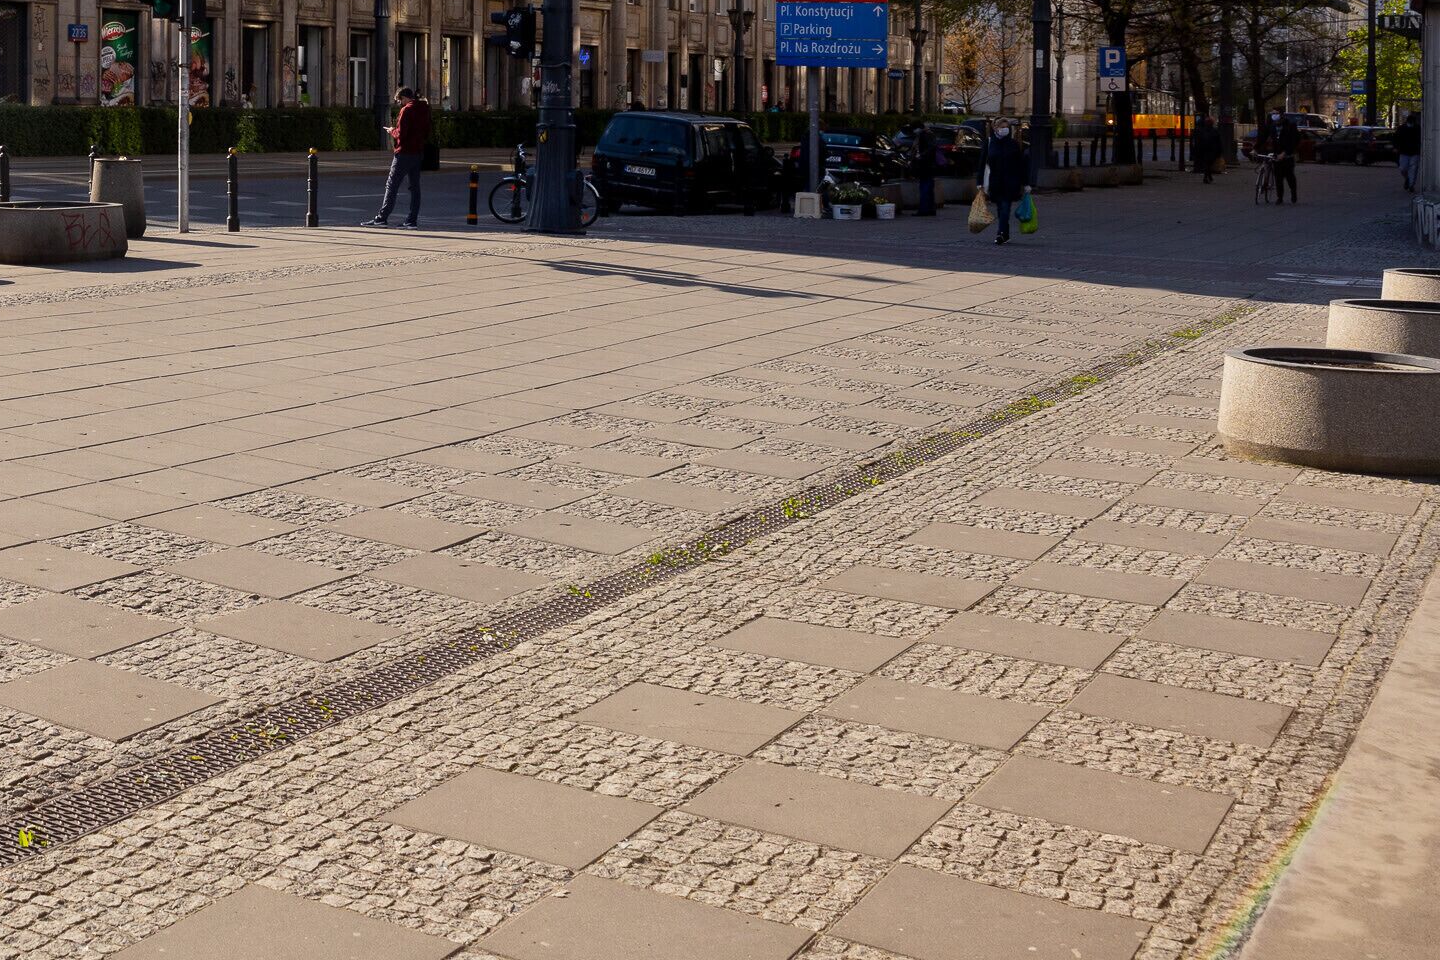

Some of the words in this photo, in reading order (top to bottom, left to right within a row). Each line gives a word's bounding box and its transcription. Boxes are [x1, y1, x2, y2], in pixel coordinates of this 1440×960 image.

[780, 6, 792, 16] Pl.
[795, 6, 854, 19] Konstytucji
[793, 23, 832, 37] Parking
[780, 42, 792, 53] Pl.
[795, 42, 809, 53] Na
[811, 42, 861, 54] Rozdrożu
[1105, 49, 1120, 69] P
